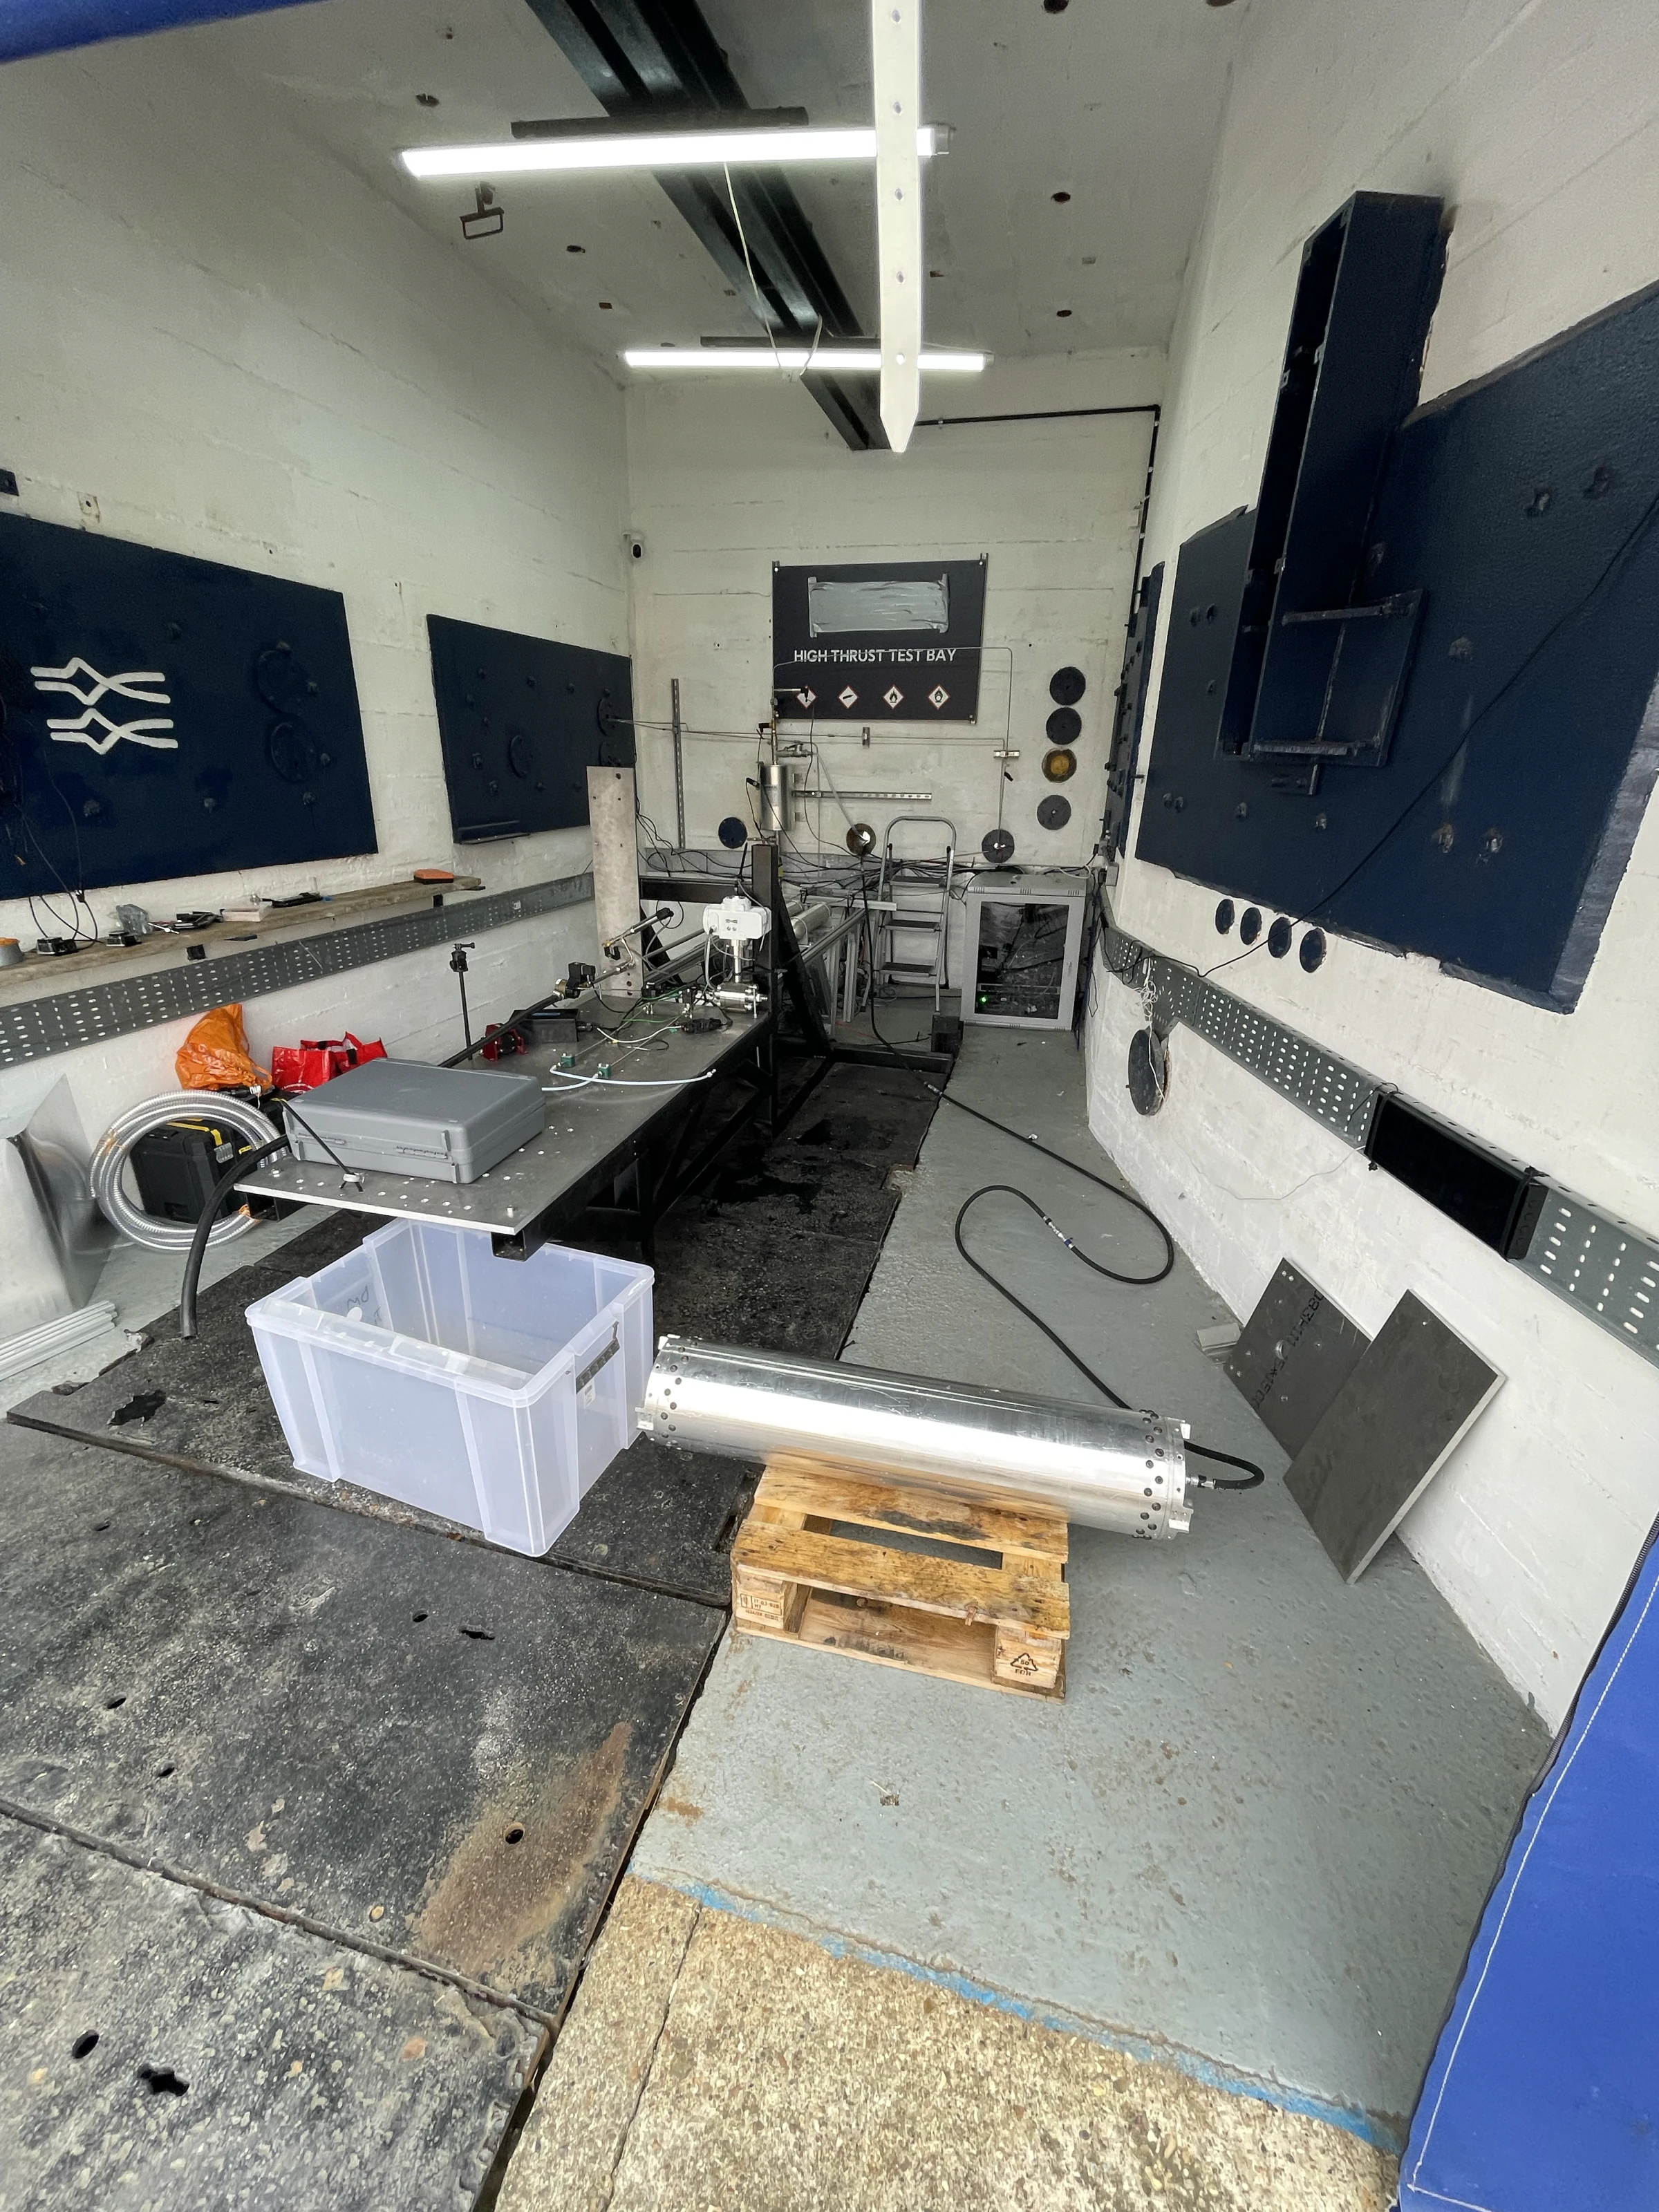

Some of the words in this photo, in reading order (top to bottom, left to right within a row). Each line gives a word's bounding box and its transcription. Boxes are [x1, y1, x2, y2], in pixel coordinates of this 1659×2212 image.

[794, 649, 827, 663] HIGH
[831, 649, 883, 662] THRUST
[888, 648, 921, 662] TEST
[926, 648, 957, 662] BAY
